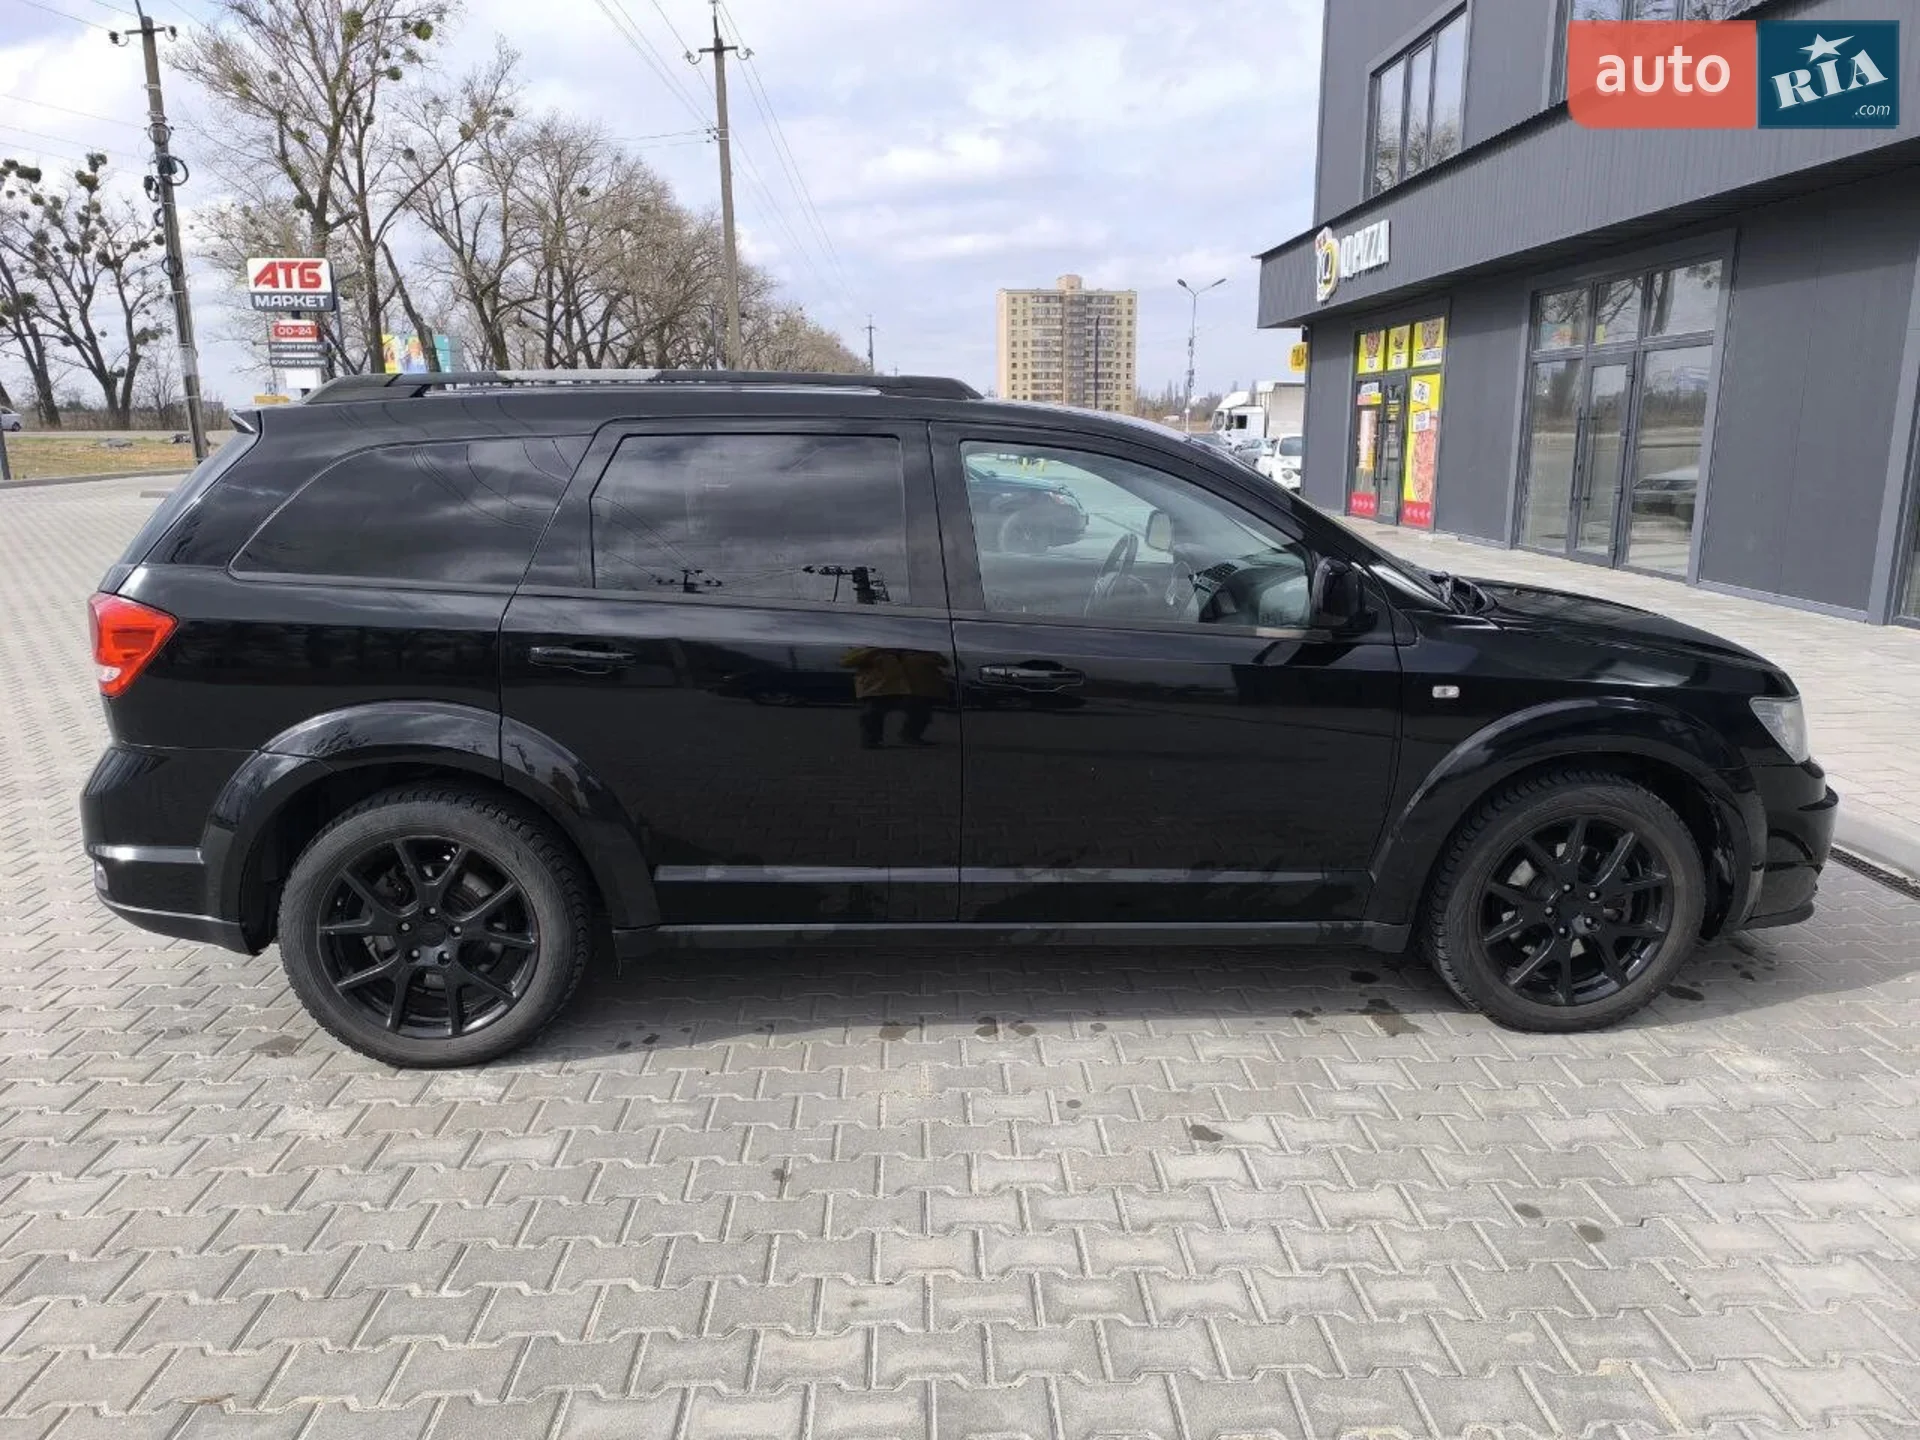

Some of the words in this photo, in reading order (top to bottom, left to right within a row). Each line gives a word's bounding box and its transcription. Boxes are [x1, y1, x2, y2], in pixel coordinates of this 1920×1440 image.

[254, 262, 323, 289] АТБ
[254, 295, 328, 308] МАРКЕТ
[277, 326, 312, 336] 00-24
